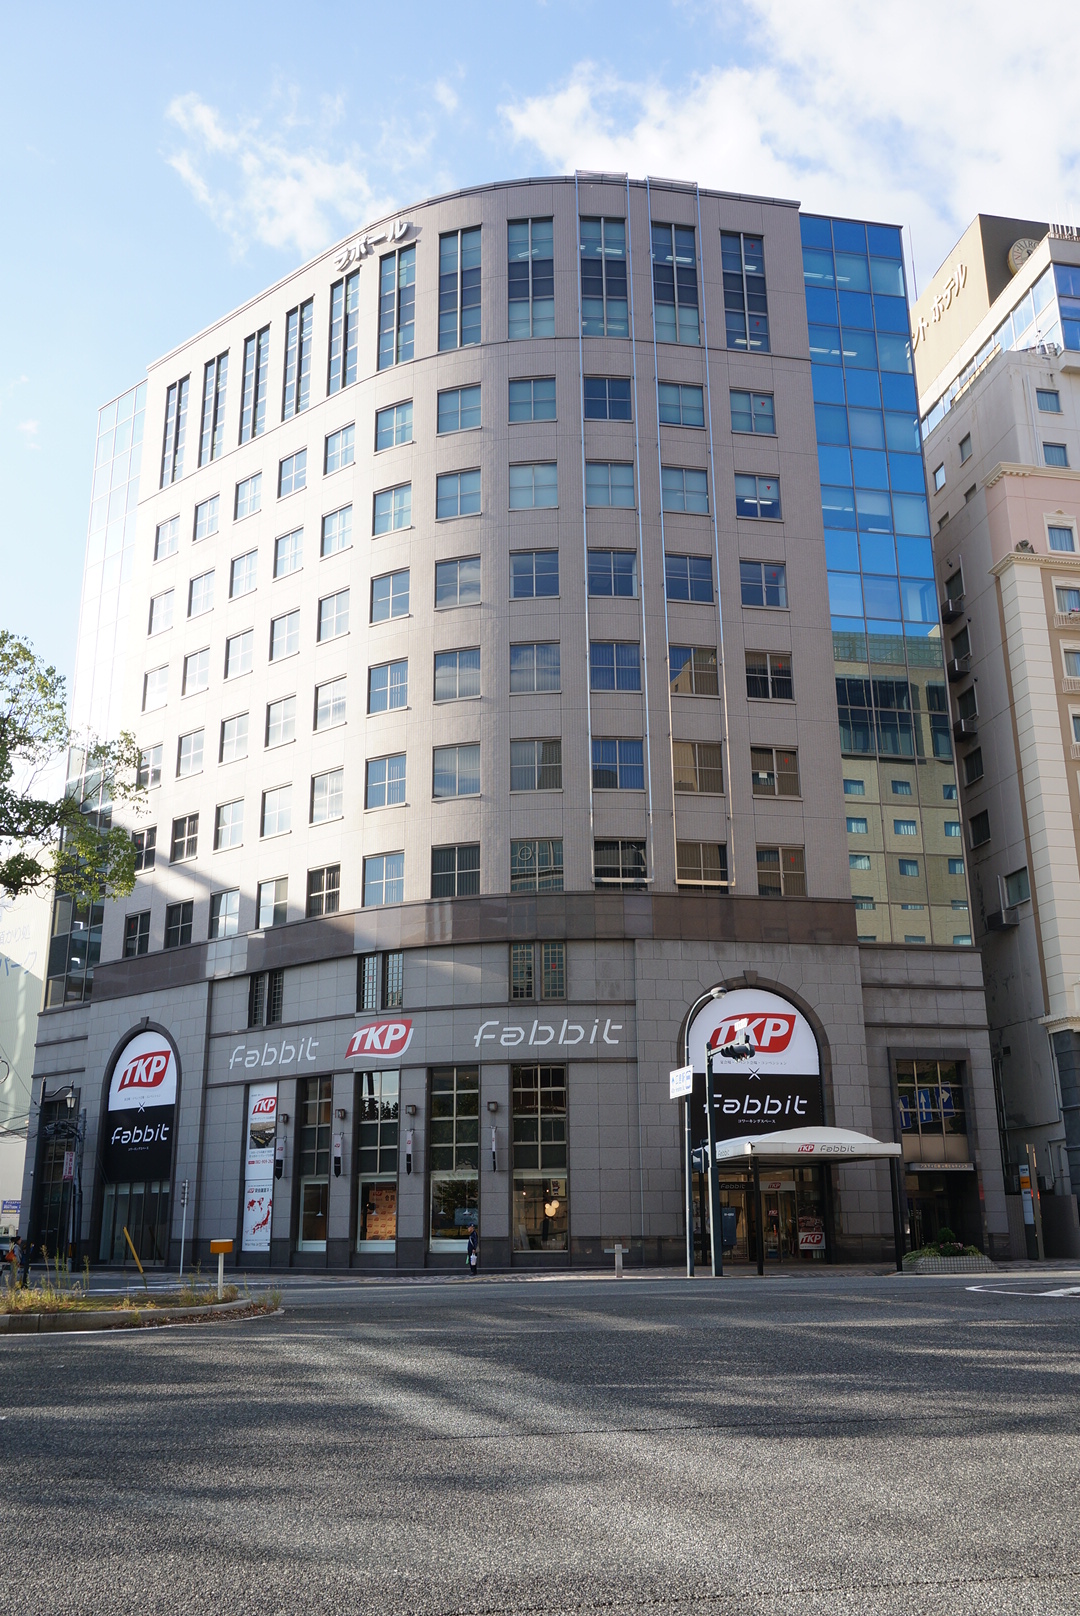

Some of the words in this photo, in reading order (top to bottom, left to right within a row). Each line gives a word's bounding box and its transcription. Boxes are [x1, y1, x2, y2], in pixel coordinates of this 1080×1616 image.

[334, 219, 409, 272] ラボール
[348, 1022, 408, 1056] TKP
[714, 1016, 791, 1048] TKP
[122, 1054, 168, 1087] TKP
[253, 1098, 276, 1113] TKP
[798, 1144, 814, 1152] TKP
[802, 1234, 822, 1243] TKP
